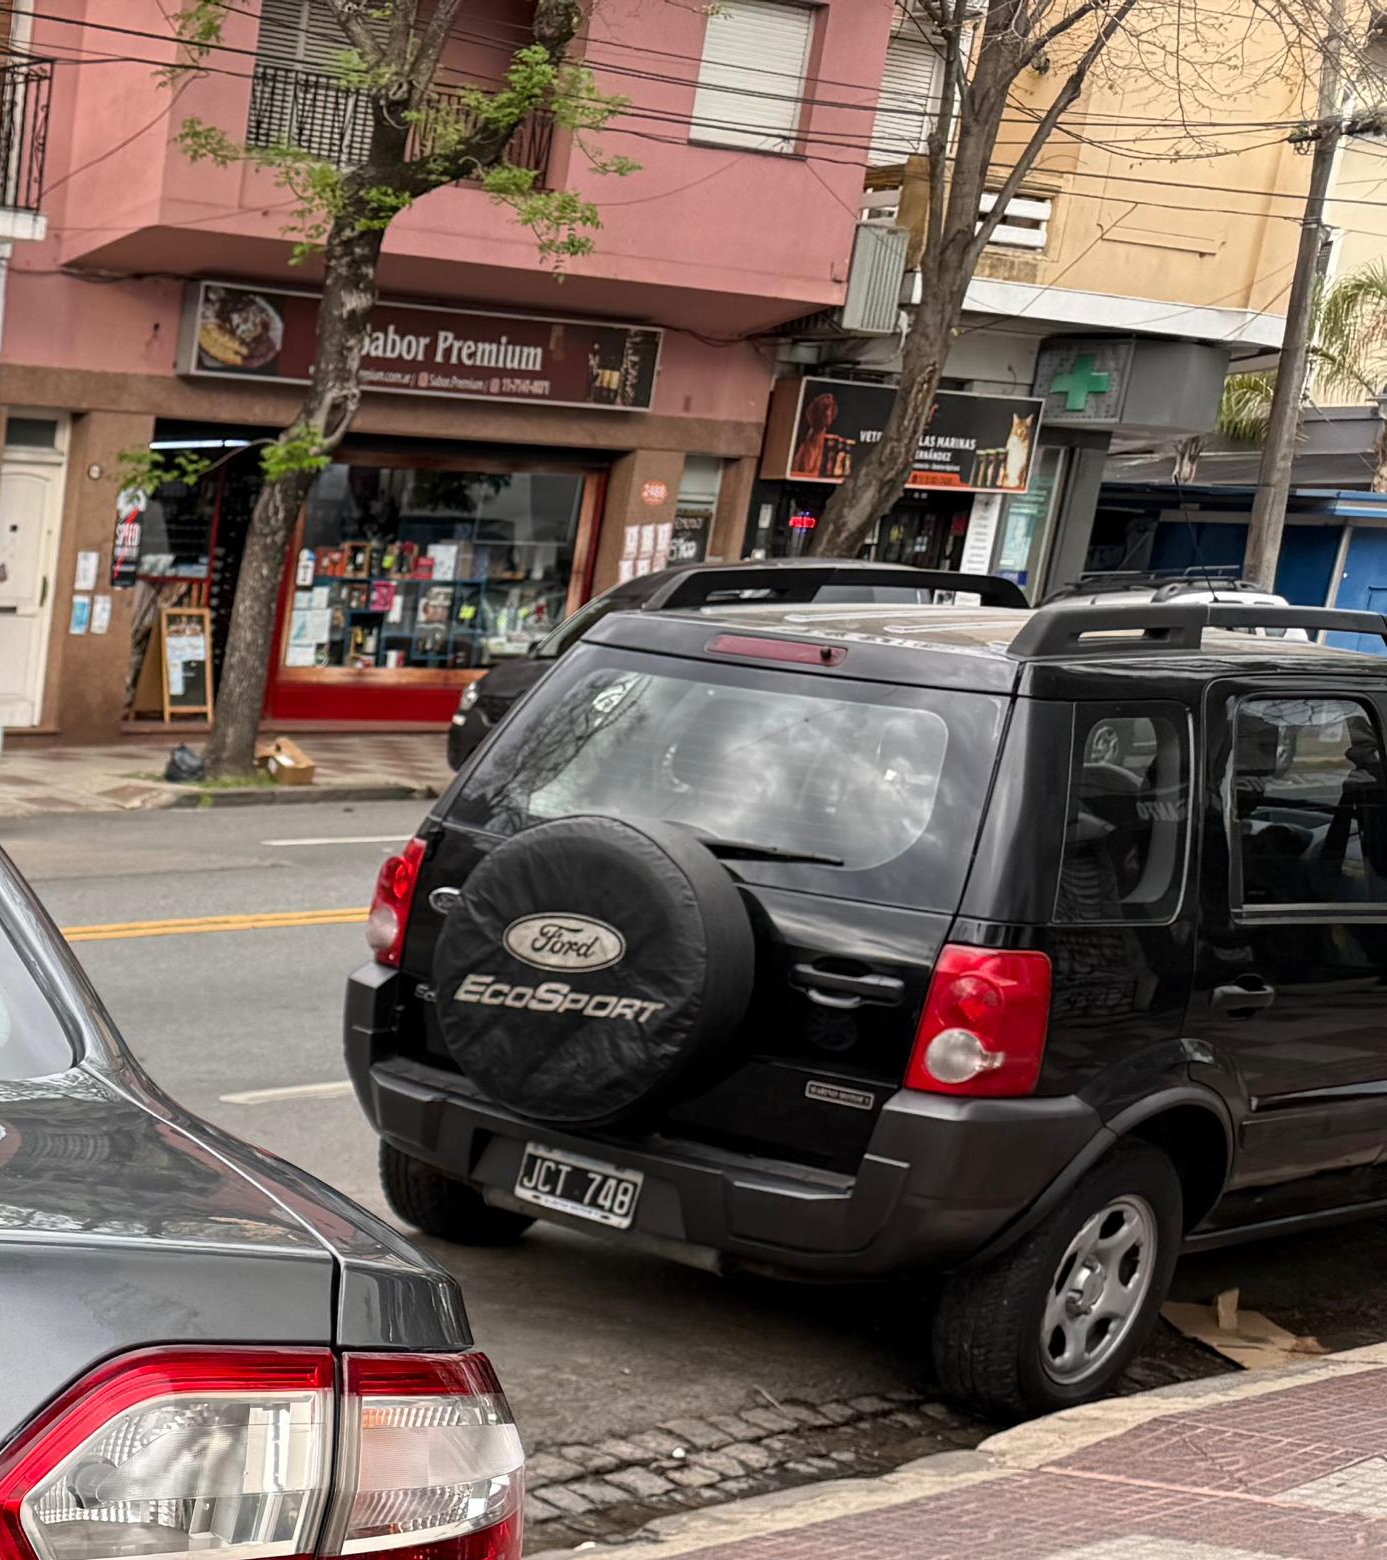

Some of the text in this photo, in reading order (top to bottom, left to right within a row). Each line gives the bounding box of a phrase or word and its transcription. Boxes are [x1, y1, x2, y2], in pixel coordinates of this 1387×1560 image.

[435, 330, 543, 371] Premium
[530, 923, 599, 958] Ford
[523, 1158, 572, 1197] JCT
[583, 1172, 634, 1216] 748
